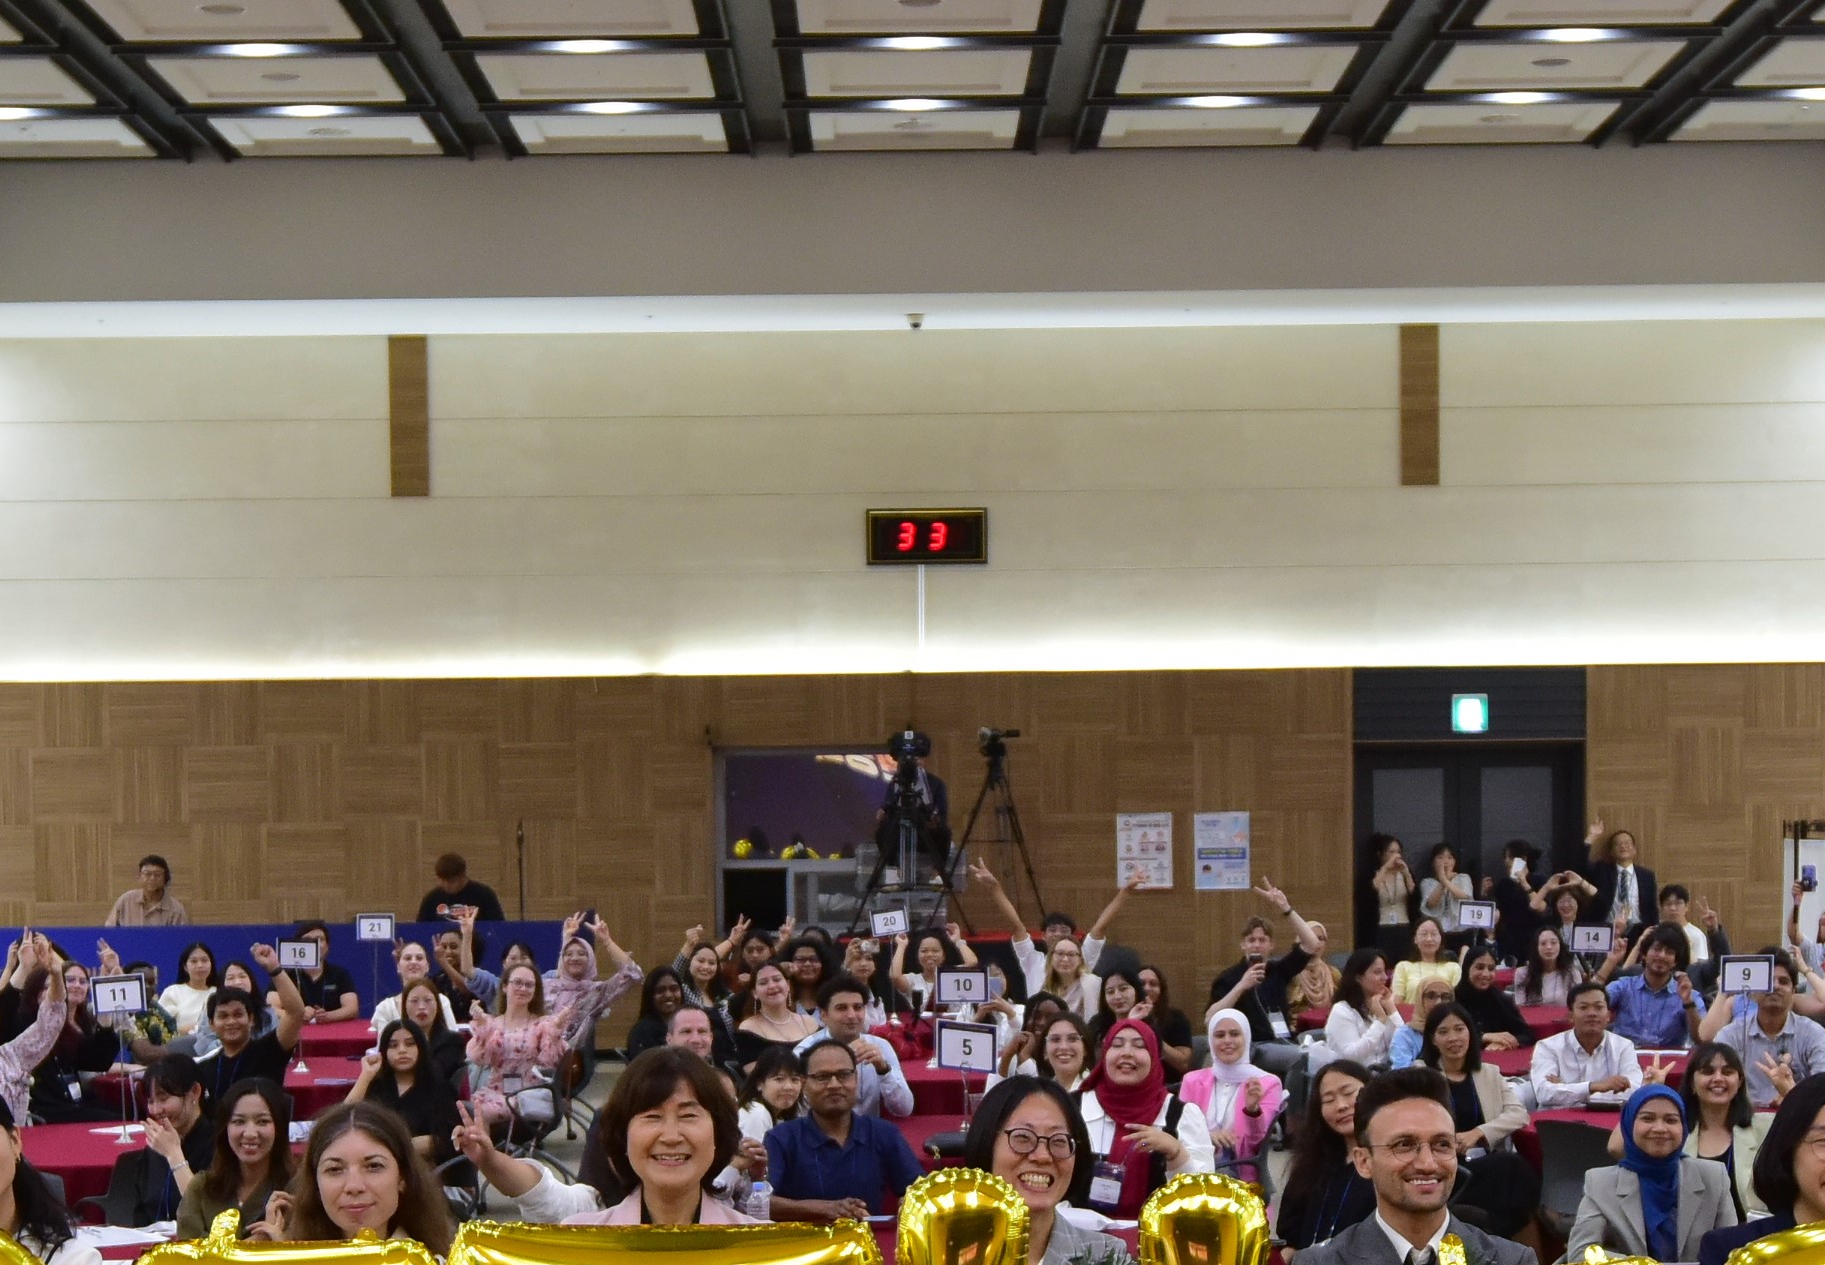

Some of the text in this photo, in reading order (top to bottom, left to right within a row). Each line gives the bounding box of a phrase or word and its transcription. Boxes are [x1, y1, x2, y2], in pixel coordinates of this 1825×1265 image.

[1470, 909, 1482, 919] 19
[882, 916, 896, 927] 20
[369, 923, 381, 933] 21
[1586, 932, 1599, 943] 14
[293, 947, 306, 959] 16
[1742, 967, 1751, 981] 9
[955, 978, 972, 992] 10
[110, 987, 126, 1002] 11
[962, 1038, 972, 1055] 5
